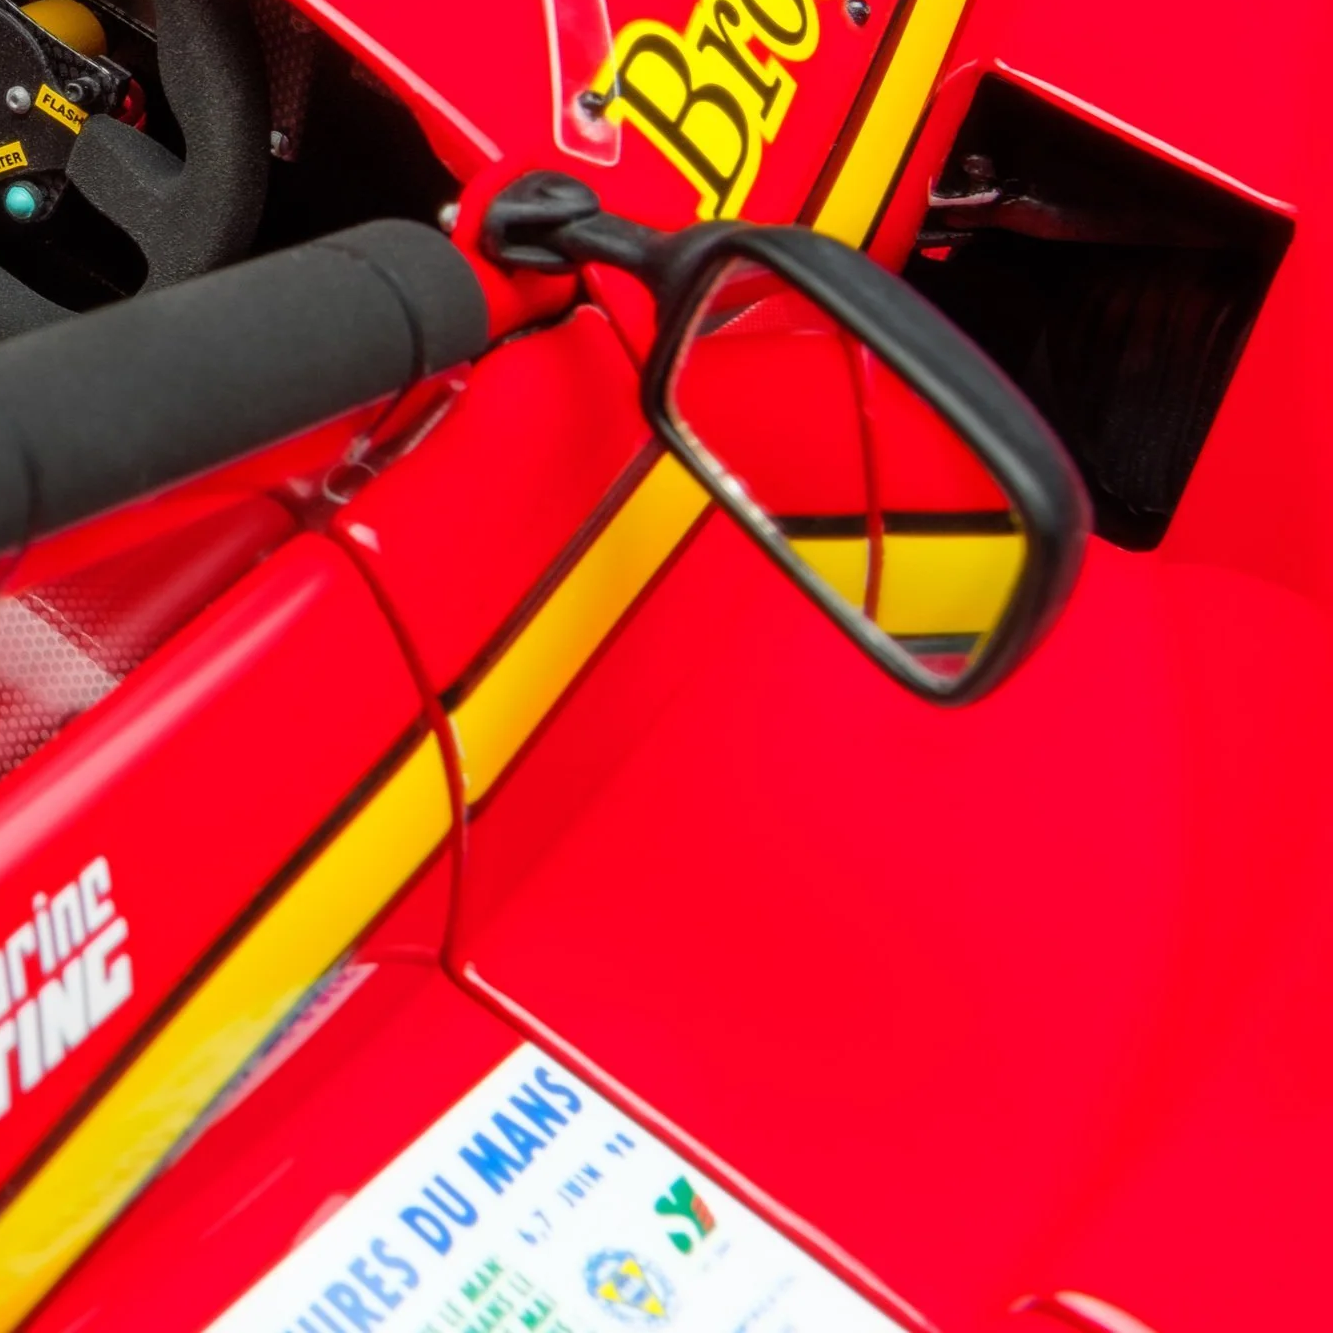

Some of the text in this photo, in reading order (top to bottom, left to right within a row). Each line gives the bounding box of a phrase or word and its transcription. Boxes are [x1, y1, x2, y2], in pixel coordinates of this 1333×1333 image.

[42, 92, 85, 127] FLASH
[399, 1173, 479, 1256] DU
[458, 1065, 583, 1195] MANS
